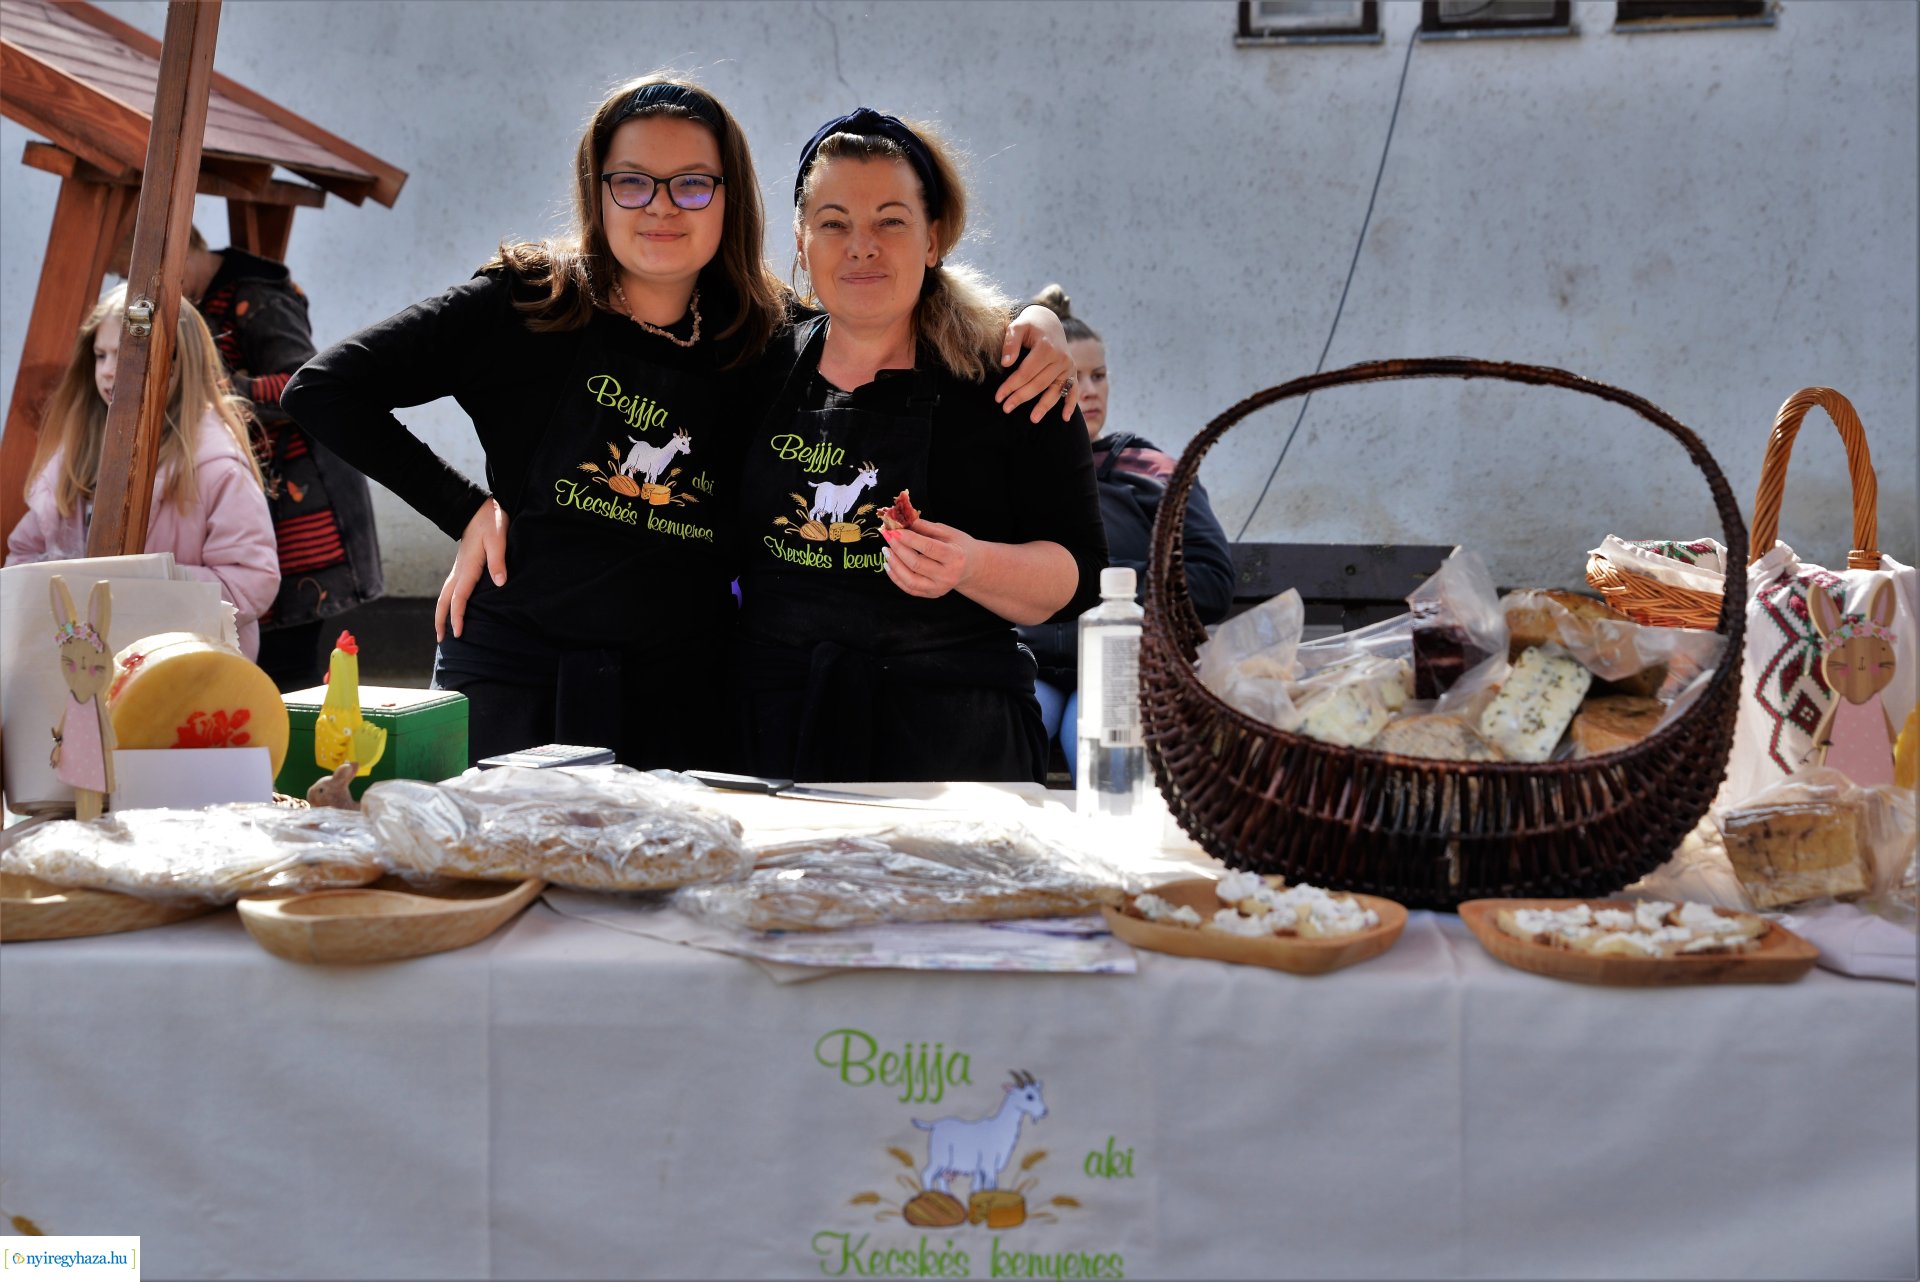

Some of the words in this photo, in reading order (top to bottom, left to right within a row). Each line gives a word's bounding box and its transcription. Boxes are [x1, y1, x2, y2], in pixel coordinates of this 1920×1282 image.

[587, 374, 669, 431] Bejjja
[771, 433, 846, 474] Bejjja
[692, 471, 715, 496] aki
[555, 479, 638, 525] Kecskés
[648, 508, 714, 543] kenyeres
[763, 535, 833, 569] Kecskés
[843, 546, 887, 573] keny
[815, 1028, 971, 1103] Bejjja
[1083, 1136, 1135, 1178] aki
[812, 1230, 970, 1277] Kecskés
[990, 1236, 1125, 1281] kenyeres
